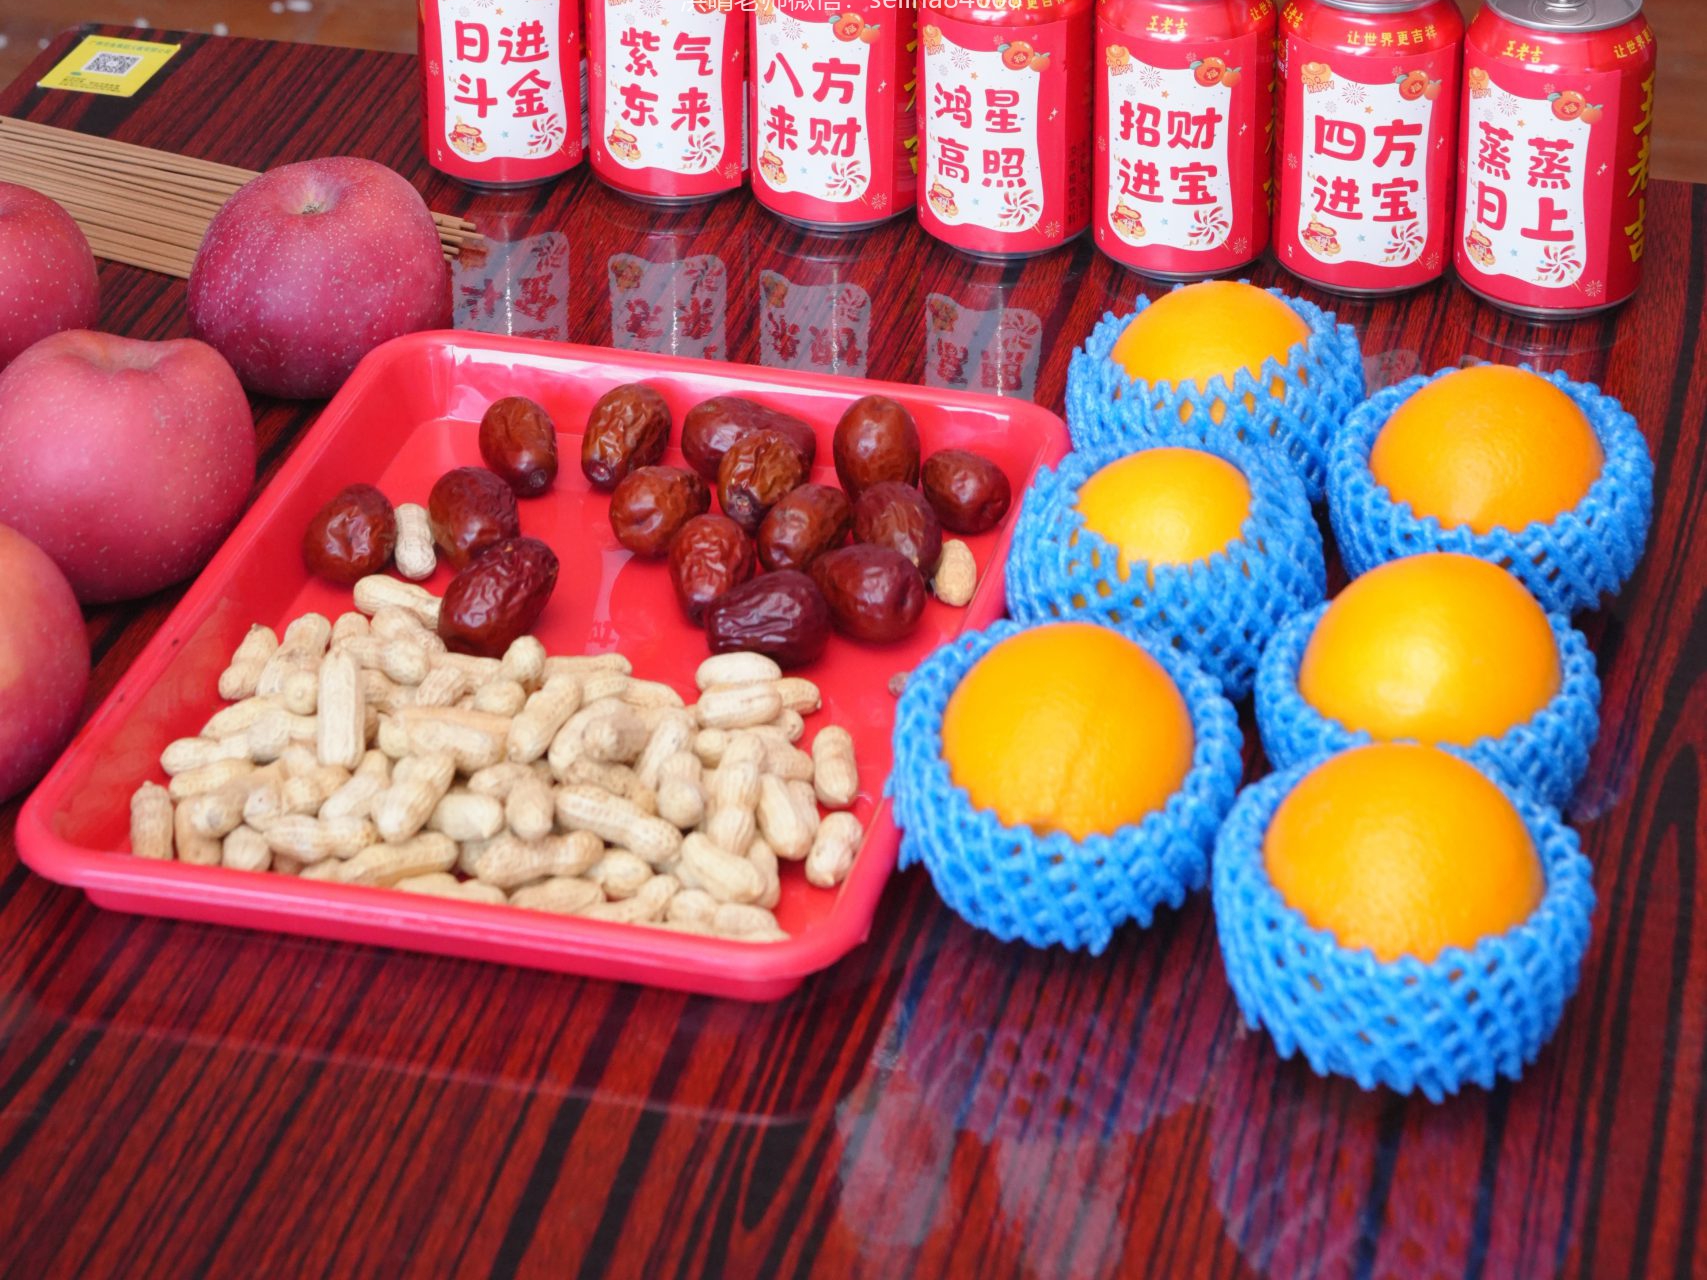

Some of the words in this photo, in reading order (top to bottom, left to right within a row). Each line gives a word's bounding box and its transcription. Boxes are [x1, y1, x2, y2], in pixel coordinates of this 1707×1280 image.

[455, 20, 549, 65] 日进
[1146, 16, 1188, 35] 王老吉
[1347, 25, 1438, 47] 让世界更吉祥
[620, 27, 714, 78] 紫气
[1502, 40, 1544, 63] 王老吉
[454, 69, 552, 119] 斗金
[763, 51, 861, 105] 八方
[620, 84, 711, 132] 东来
[766, 105, 862, 158] 来财
[934, 82, 1023, 135] 鸿星
[1119, 99, 1223, 150] 招财
[936, 136, 1027, 188] 高照
[1314, 115, 1423, 168] 四方
[1478, 121, 1575, 190] 蒸蒸
[1118, 158, 1218, 206] 进宝
[1312, 175, 1420, 223] 进宝
[1477, 181, 1575, 242] 日上
